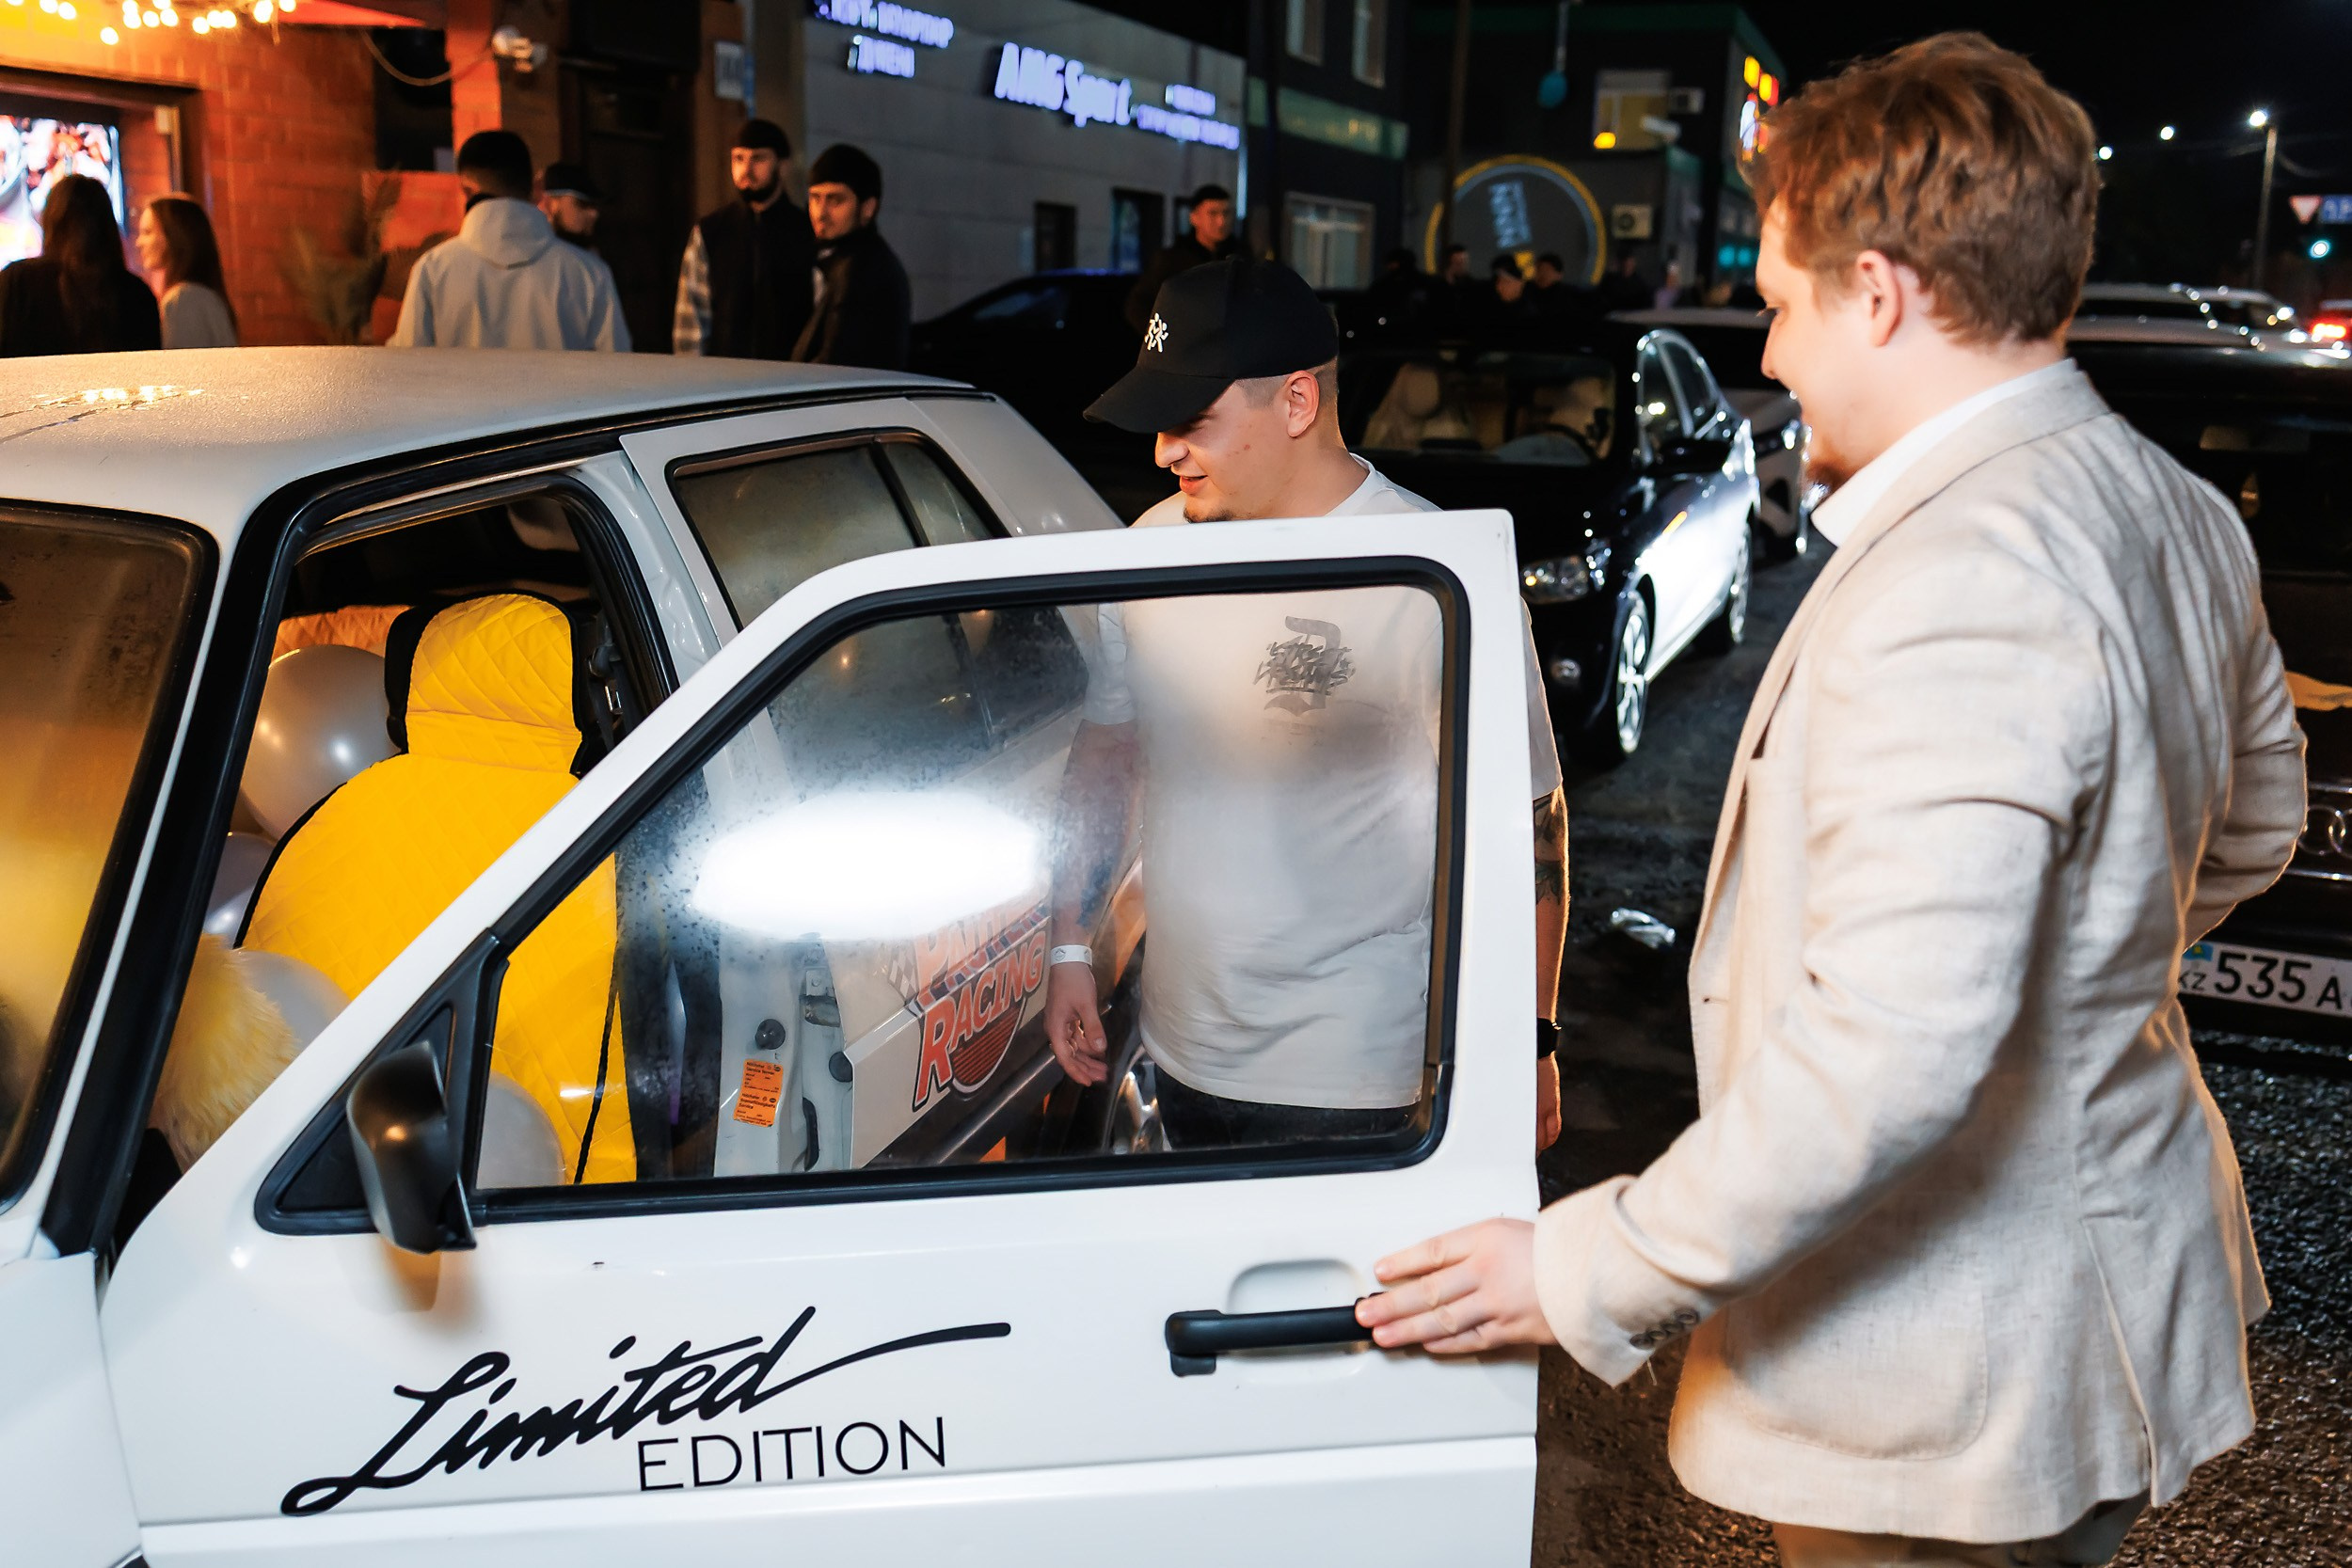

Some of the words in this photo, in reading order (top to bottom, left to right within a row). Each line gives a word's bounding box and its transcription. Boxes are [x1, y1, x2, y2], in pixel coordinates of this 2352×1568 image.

[1063, 59, 1132, 128] Sport
[2214, 951, 2312, 1003] 535
[2315, 975, 2352, 1010] A
[914, 929, 1046, 1111] RACING
[280, 1306, 1011, 1517] Limited
[638, 1417, 946, 1492] EDITION
